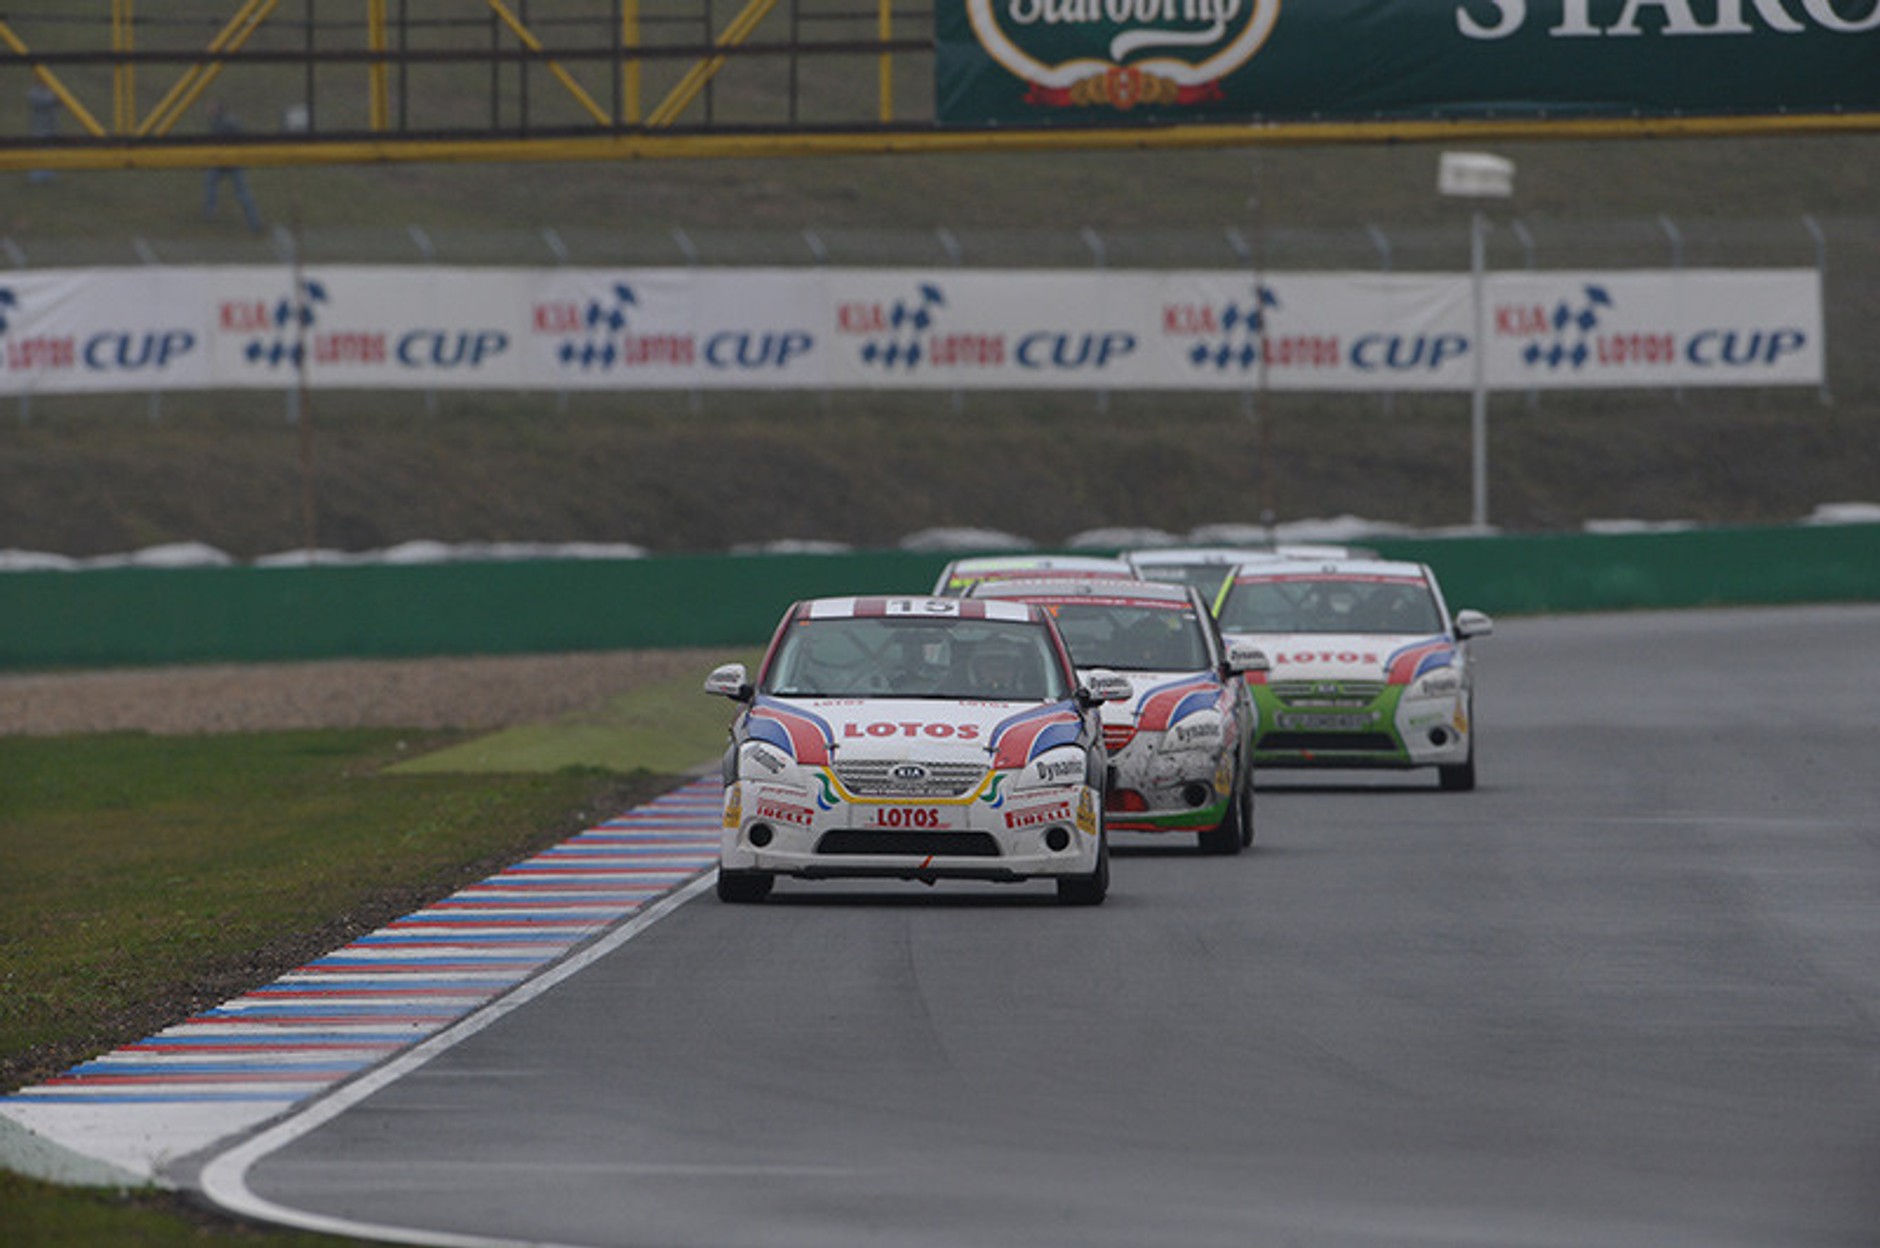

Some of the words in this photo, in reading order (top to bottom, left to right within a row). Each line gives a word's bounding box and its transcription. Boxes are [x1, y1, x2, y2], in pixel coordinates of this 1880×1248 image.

[81, 330, 196, 369] CUP
[394, 330, 508, 368] CUP
[703, 330, 814, 368] CUP
[1014, 330, 1138, 368] CUP
[1348, 333, 1470, 369] CUP
[1598, 333, 1676, 364] LOTOS
[1685, 329, 1806, 366] CUP
[1276, 652, 1378, 664] LOTOS
[844, 722, 980, 740] LOTOS
[898, 768, 922, 777] KIA
[877, 808, 940, 828] LOTOS
[1004, 801, 1071, 829] PIRELLI
